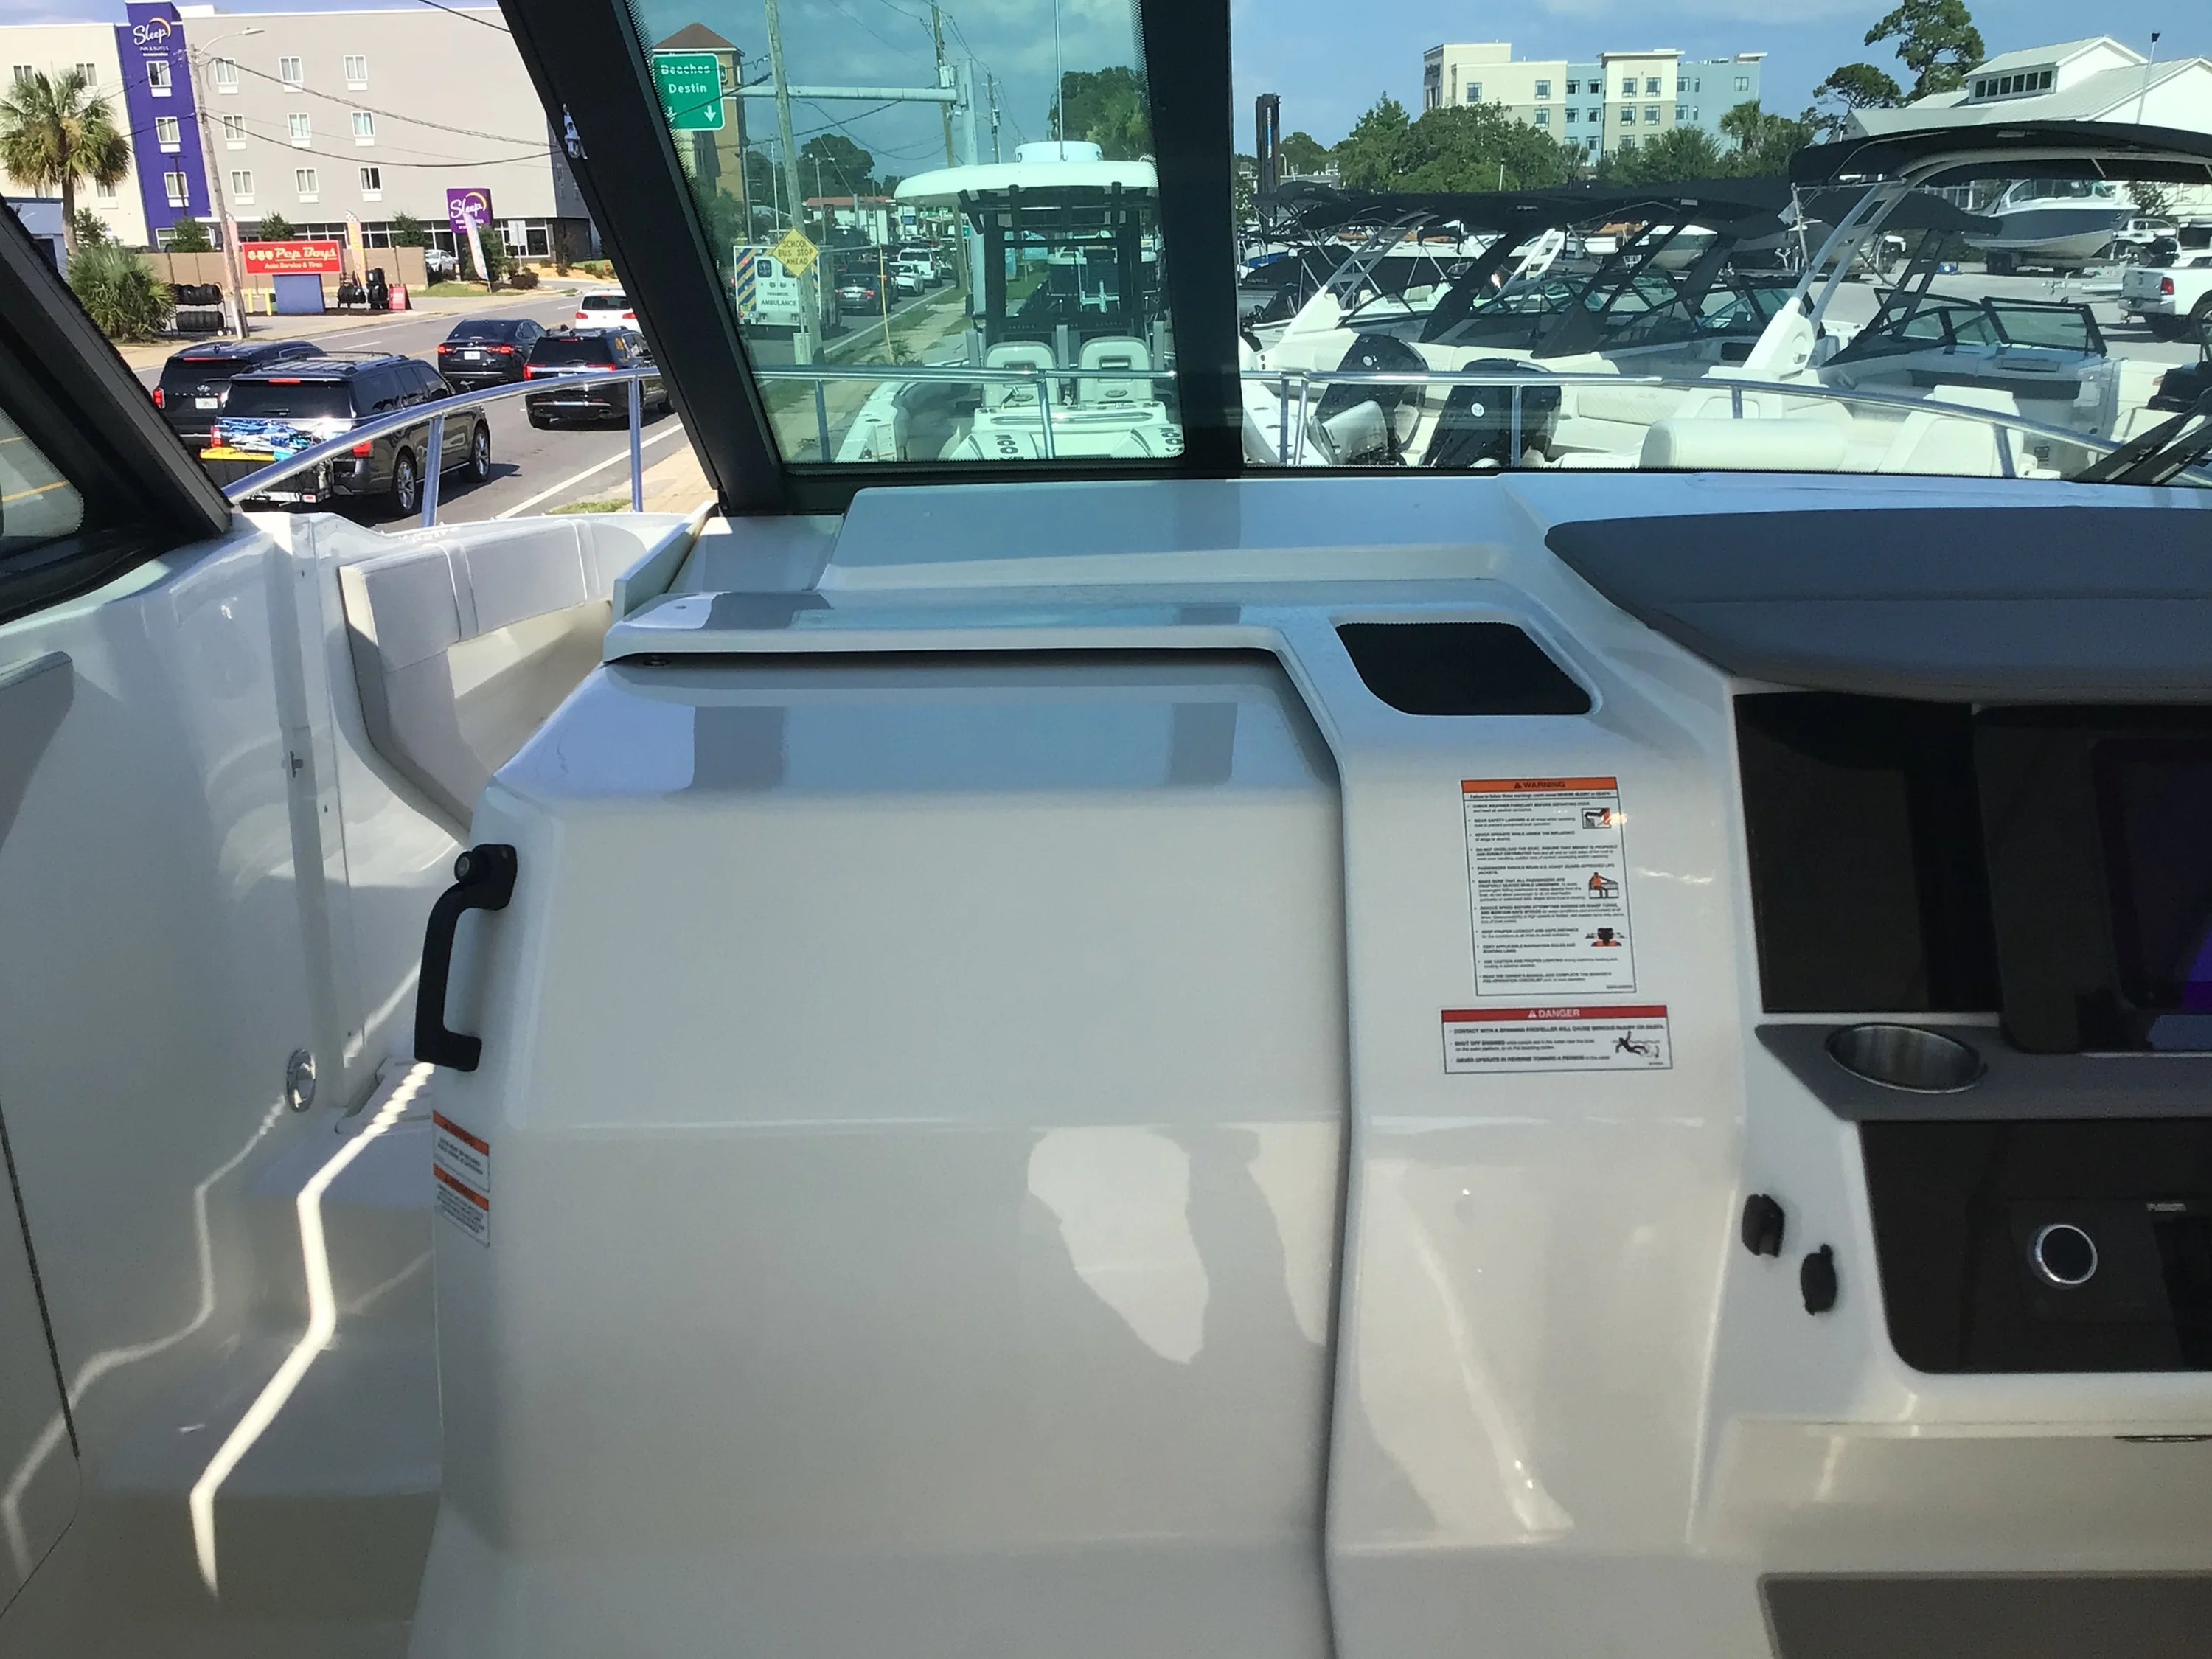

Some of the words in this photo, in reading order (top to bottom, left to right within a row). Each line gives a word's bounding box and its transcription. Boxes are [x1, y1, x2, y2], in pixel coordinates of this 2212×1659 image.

[133, 24, 167, 45] Sleep
[661, 64, 710, 74] Beaches
[669, 83, 707, 94] Destin
[450, 198, 483, 218] Sleep
[274, 247, 301, 260] Pep
[302, 246, 337, 261] Boys
[1523, 781, 1566, 789] WARNING
[1538, 1009, 1580, 1018] DANGER
